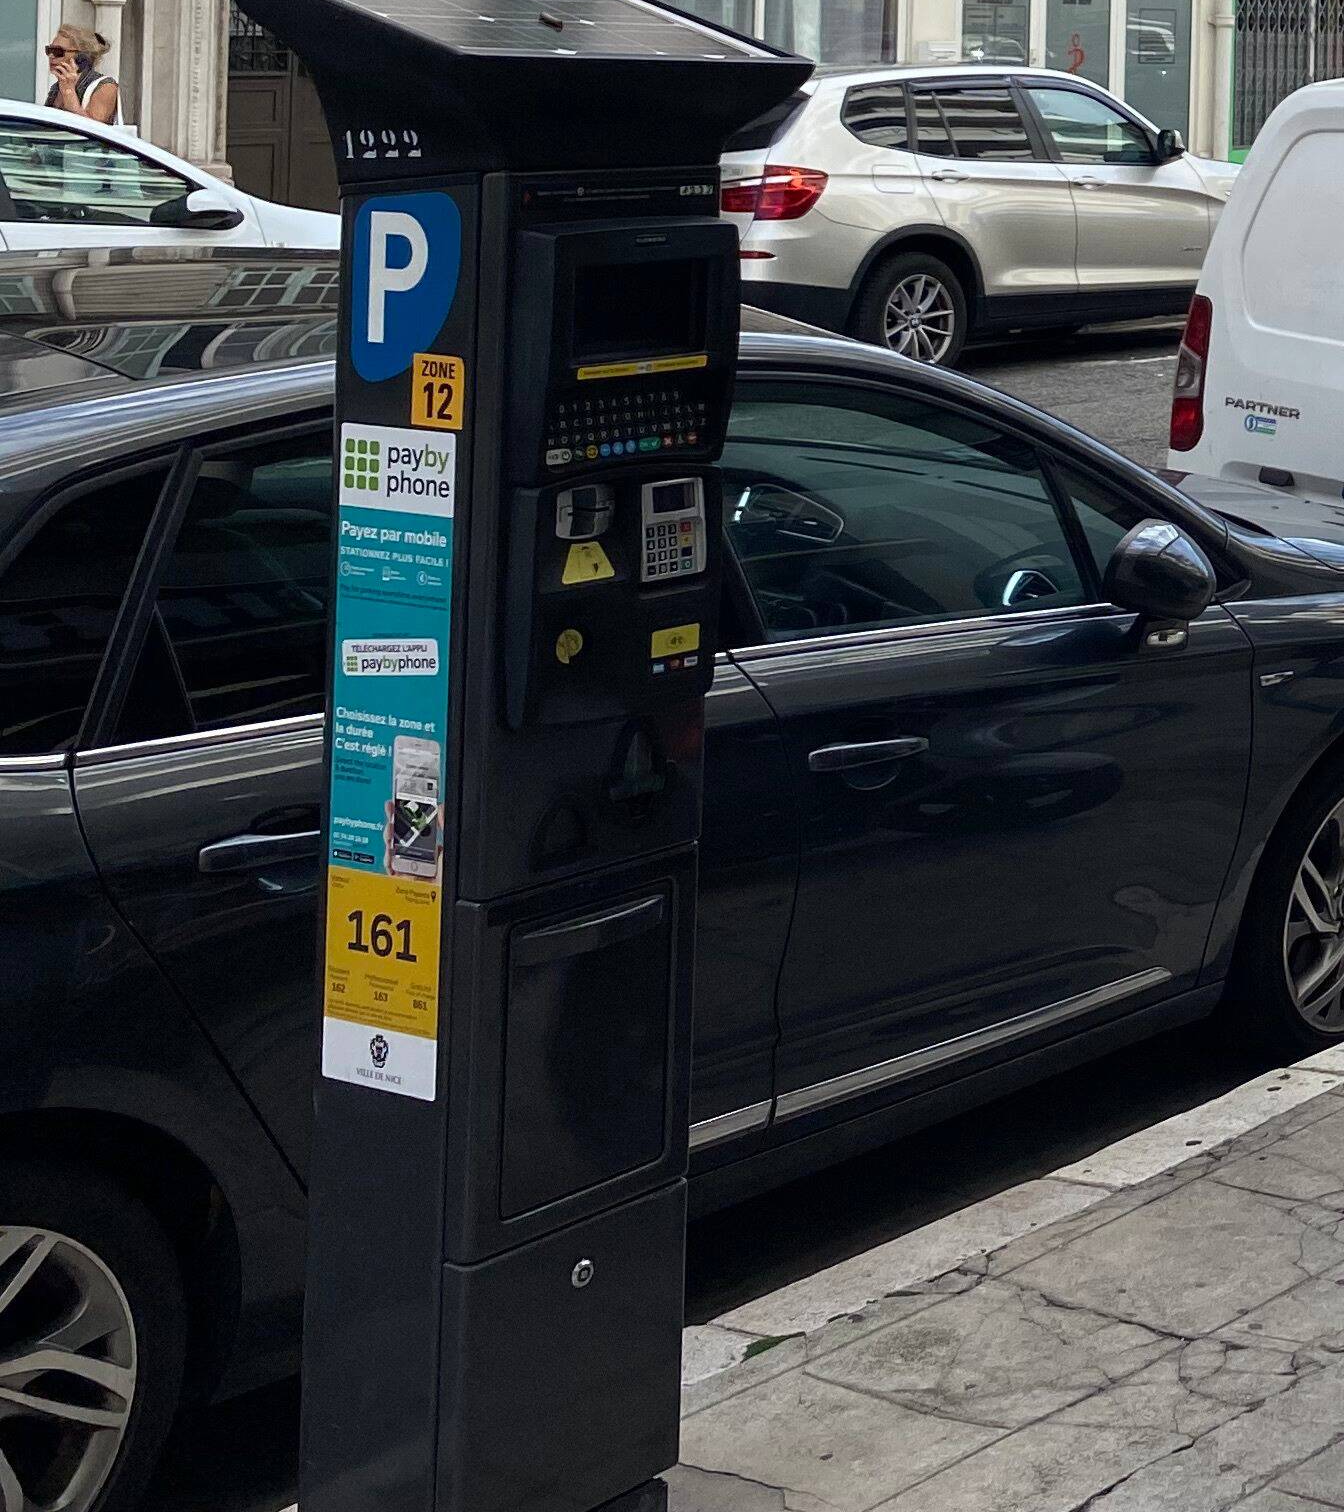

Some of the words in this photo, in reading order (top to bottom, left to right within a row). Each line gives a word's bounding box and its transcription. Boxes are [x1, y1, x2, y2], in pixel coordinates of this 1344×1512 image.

[344, 129, 422, 159] 1222
[367, 210, 429, 344] P
[421, 359, 456, 379] ZONE
[423, 382, 453, 420] 12
[1224, 396, 1300, 419] PARTNER
[386, 471, 450, 498] phone
[341, 520, 378, 541] Payez
[380, 528, 402, 543] par
[404, 530, 447, 548] mobile
[340, 546, 390, 561] STATIONNEZ
[392, 552, 413, 563] PLUS
[361, 655, 437, 673] paybyphone
[335, 722, 344, 734] la
[336, 706, 386, 725] Choisissez
[388, 714, 397, 726] la
[399, 718, 423, 731] zone
[424, 722, 436, 733] et
[347, 909, 417, 963] 161
[331, 982, 346, 994] 162
[373, 990, 388, 1002] 163
[356, 1067, 373, 1079] VILLE
[375, 1072, 385, 1081] DE
